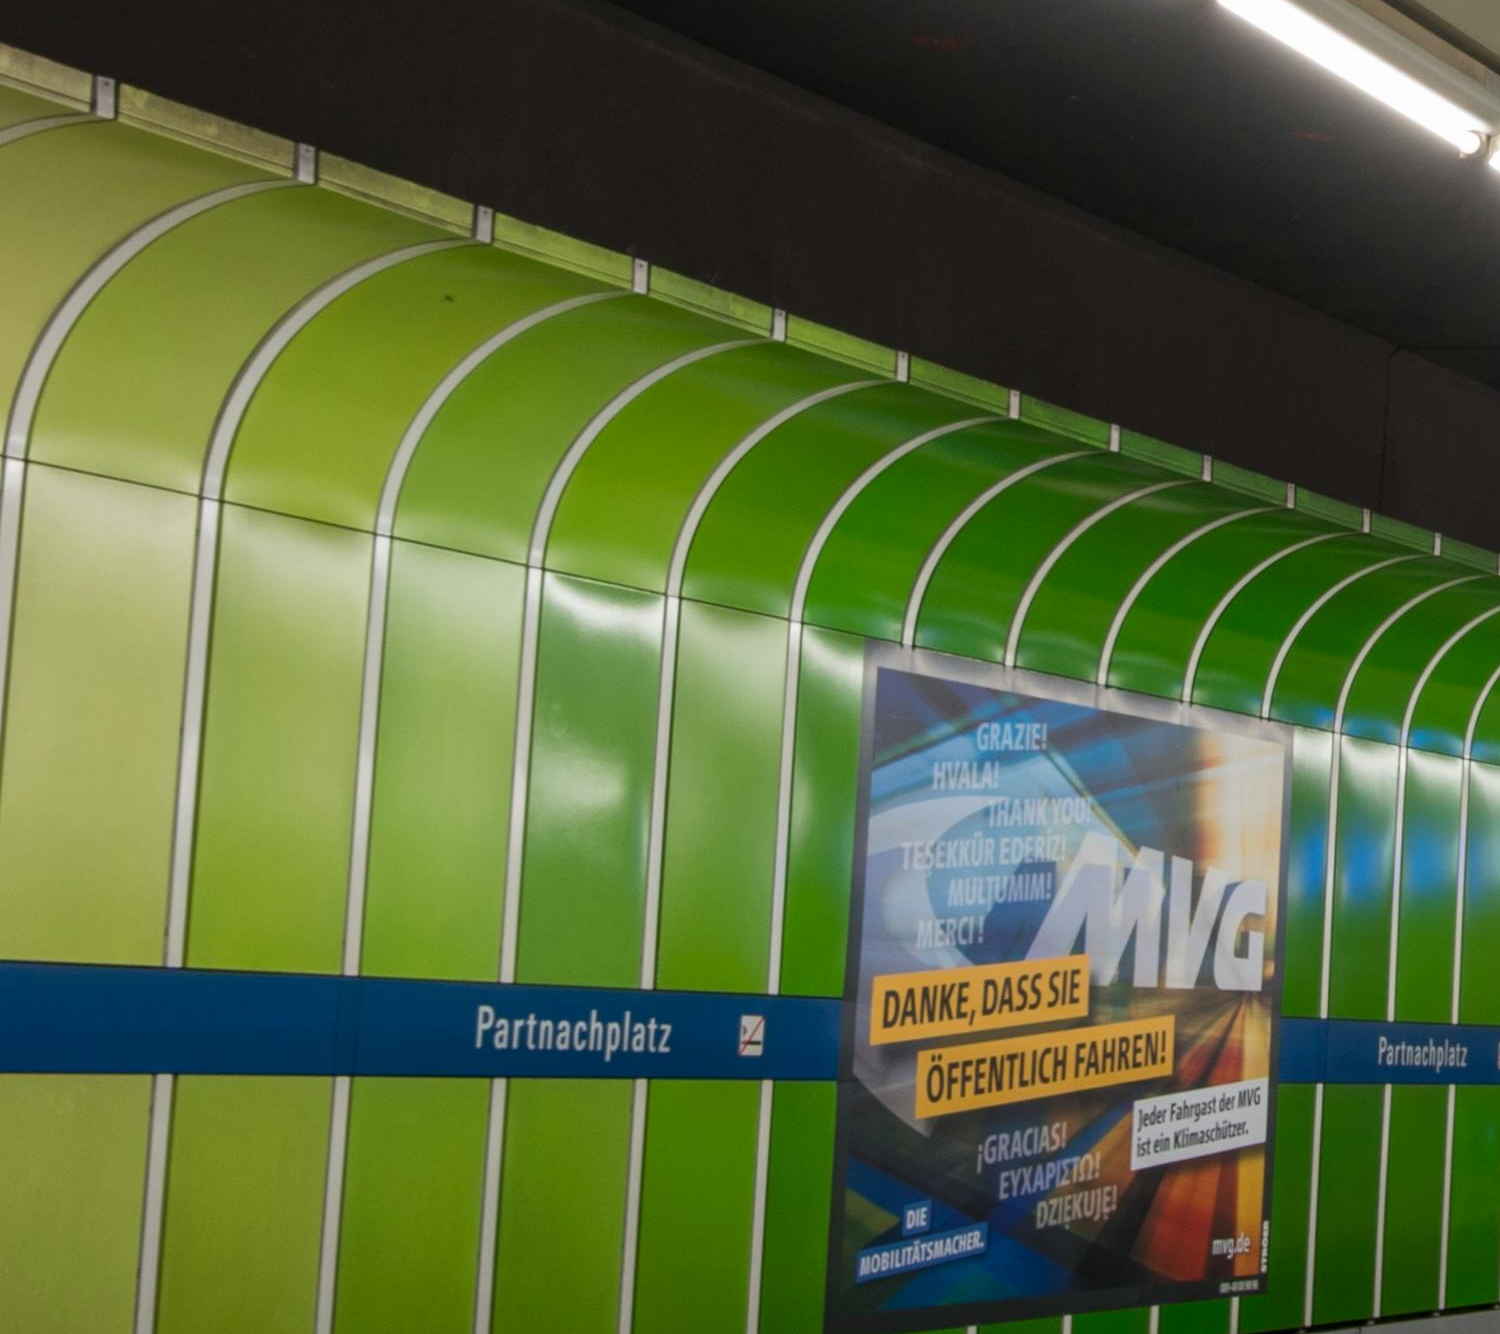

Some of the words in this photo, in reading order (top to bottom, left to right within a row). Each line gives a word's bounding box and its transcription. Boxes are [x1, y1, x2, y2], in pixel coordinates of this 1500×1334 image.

[976, 722, 1048, 751] GRAZIE!
[932, 761, 1000, 790] HVALA!
[988, 797, 1048, 827] THANK
[1052, 796, 1092, 824] YOU!
[901, 830, 995, 876] TEŞEKKÜR
[1022, 831, 1267, 993] MVG
[881, 979, 976, 1030] DANKE,
[981, 972, 1041, 1017] DASS
[1047, 968, 1081, 1008] SIE
[474, 1005, 672, 1062] Partnachplatz
[1377, 1036, 1468, 1074] Partnachplatz
[926, 1044, 1068, 1104] ÖFFENTLICH
[1073, 1030, 1167, 1078] FAHREN!
[1137, 1105, 1168, 1132] Jeder
[1169, 1097, 1217, 1122] Fahrgast
[1218, 1092, 1236, 1112] der
[1237, 1087, 1261, 1108] MVG
[977, 1121, 1068, 1174] ¡GRACIAS!
[1136, 1136, 1151, 1158] ist
[1152, 1132, 1171, 1154] ein
[1173, 1119, 1249, 1150] Klimaschützer.
[906, 1207, 928, 1229] DIE
[859, 1230, 985, 1277] MOBILITÄTSMACHER.
[1212, 1231, 1251, 1259] mvg.de
